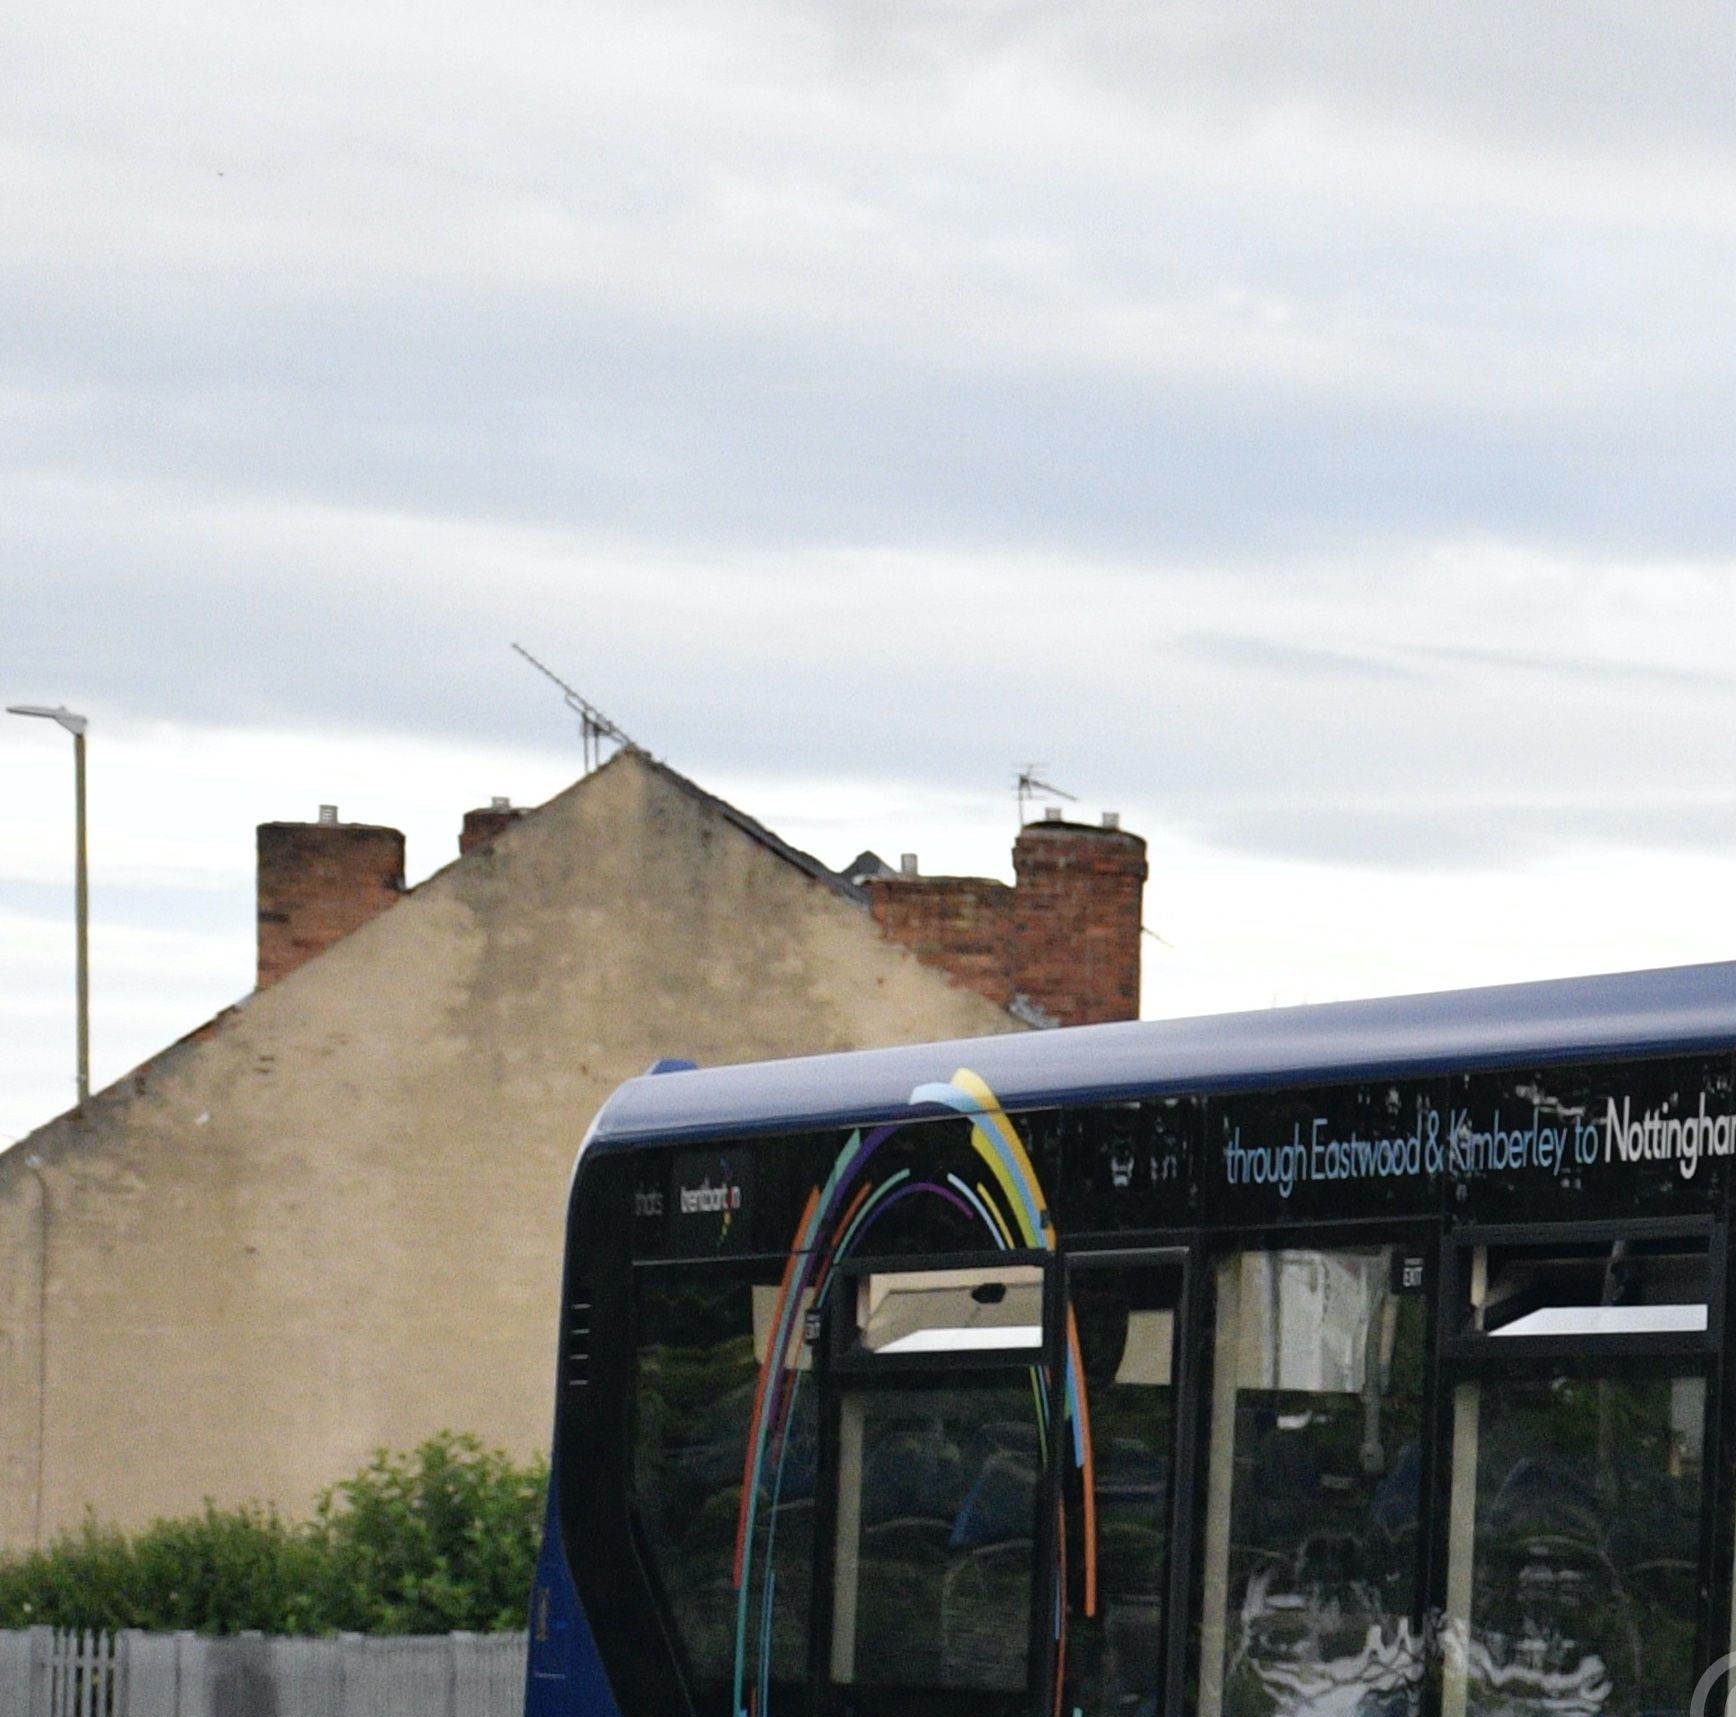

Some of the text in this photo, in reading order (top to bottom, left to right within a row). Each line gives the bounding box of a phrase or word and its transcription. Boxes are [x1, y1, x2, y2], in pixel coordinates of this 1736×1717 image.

[1226, 1126, 1307, 1198] through
[1310, 1108, 1422, 1180] Eastwood
[1424, 1109, 1445, 1174] &
[1449, 1108, 1567, 1176] Kimberley
[1574, 1116, 1599, 1165] to
